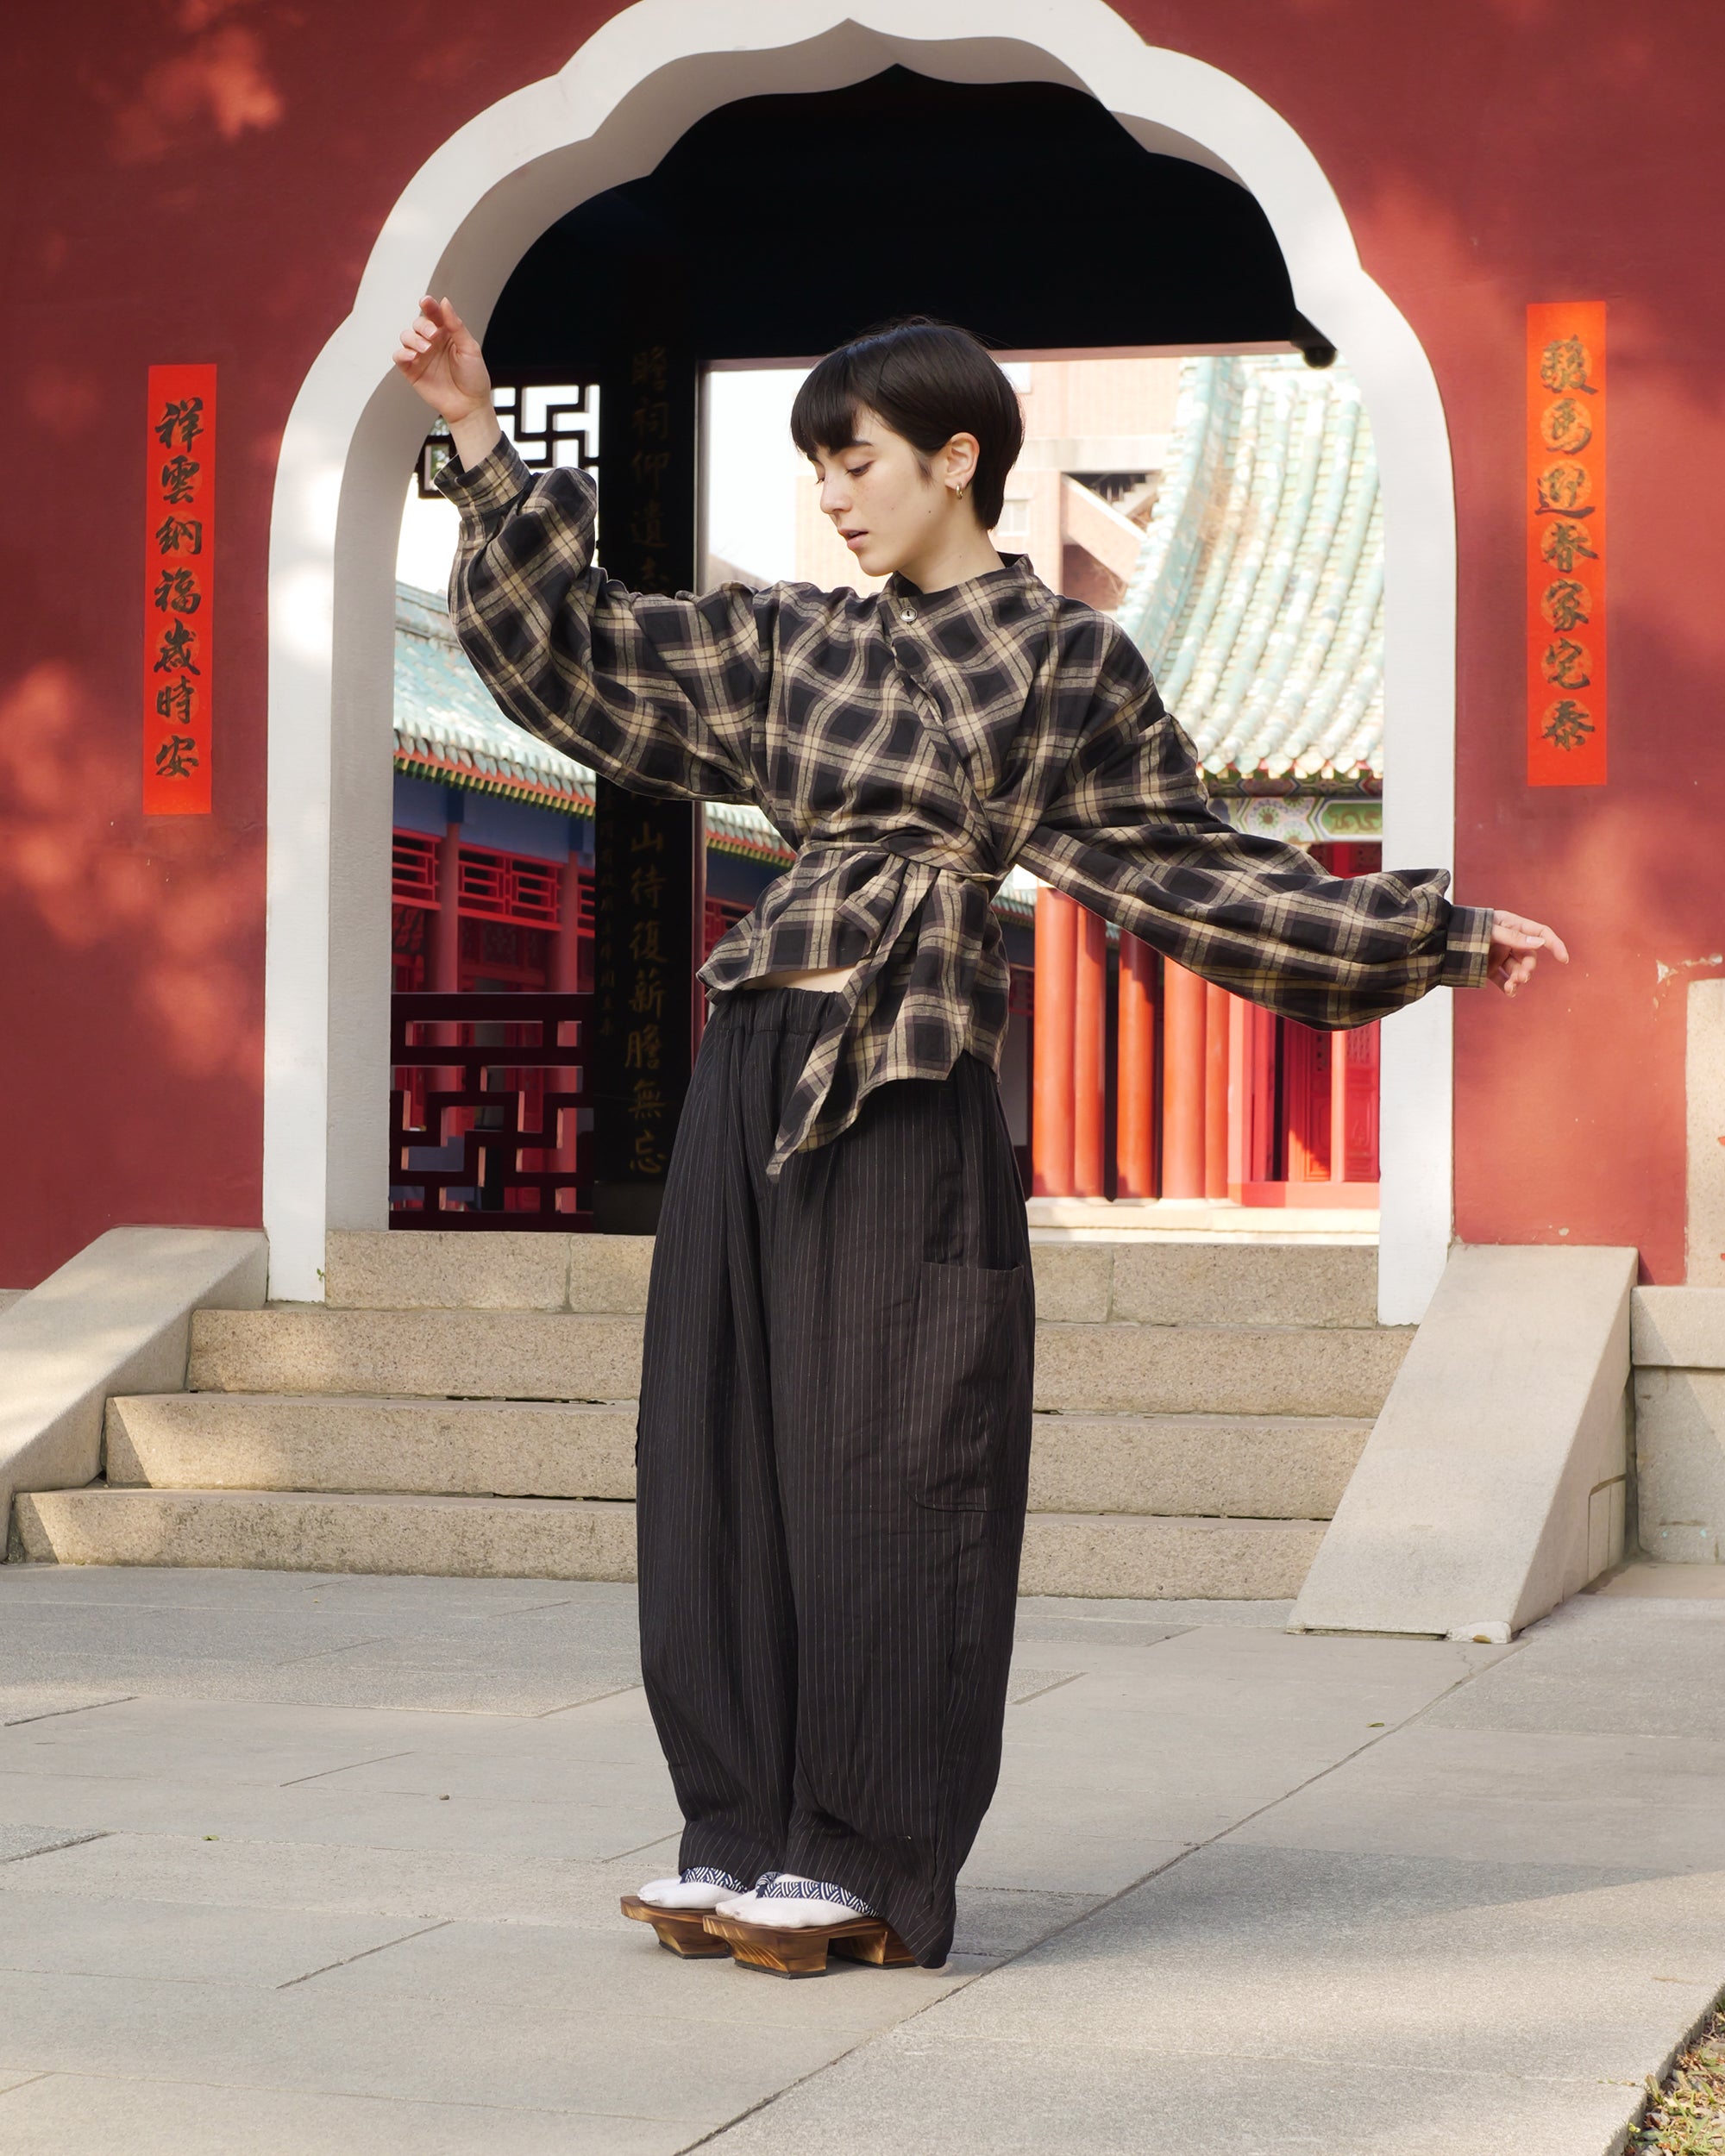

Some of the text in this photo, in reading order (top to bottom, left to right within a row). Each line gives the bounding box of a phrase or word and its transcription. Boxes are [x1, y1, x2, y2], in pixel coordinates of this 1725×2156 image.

[624, 792, 670, 1174] 山待復薪膽無忘
